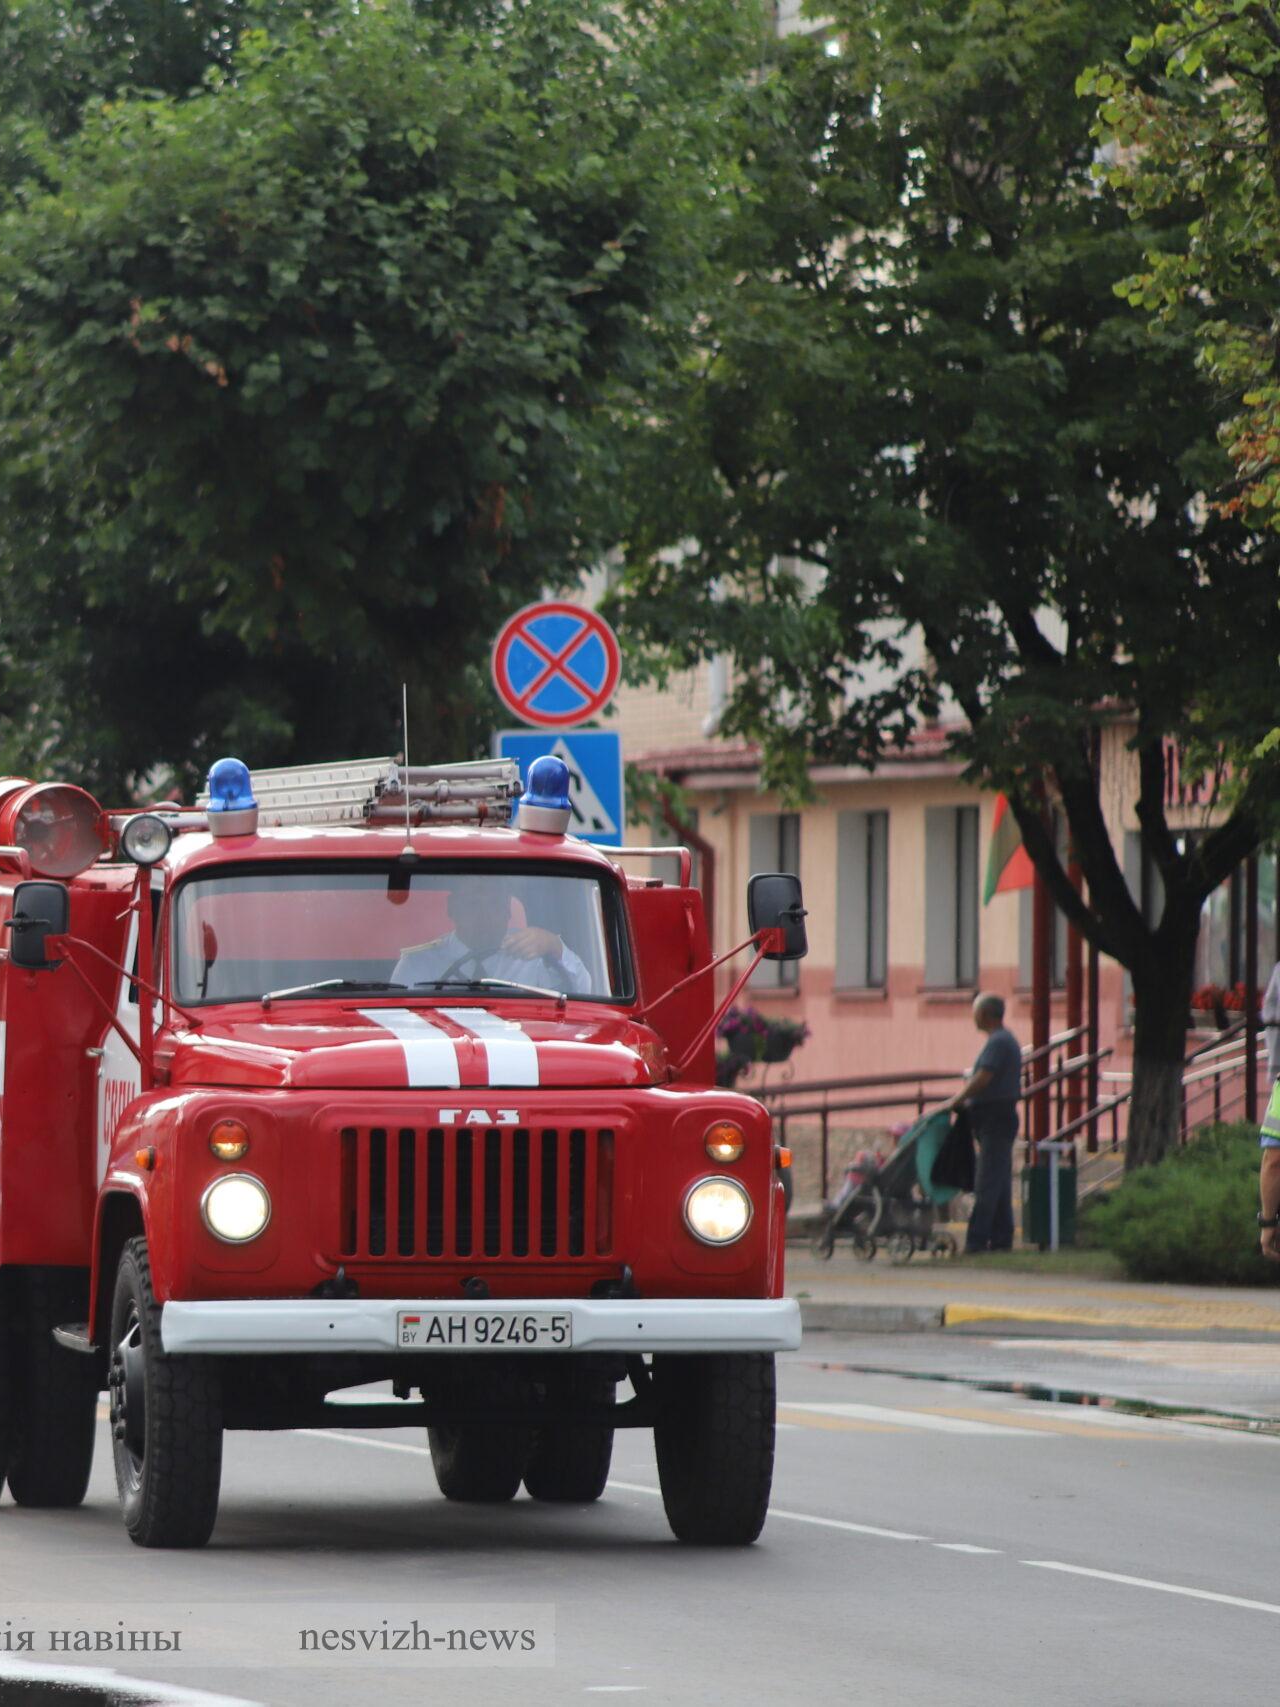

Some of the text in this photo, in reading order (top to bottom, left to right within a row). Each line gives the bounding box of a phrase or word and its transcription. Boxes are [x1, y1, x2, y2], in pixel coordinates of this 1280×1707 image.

[439, 1109, 520, 1124] ГАЗ
[426, 1316, 566, 1343] AH 9246-5
[402, 1332, 416, 1343] BY
